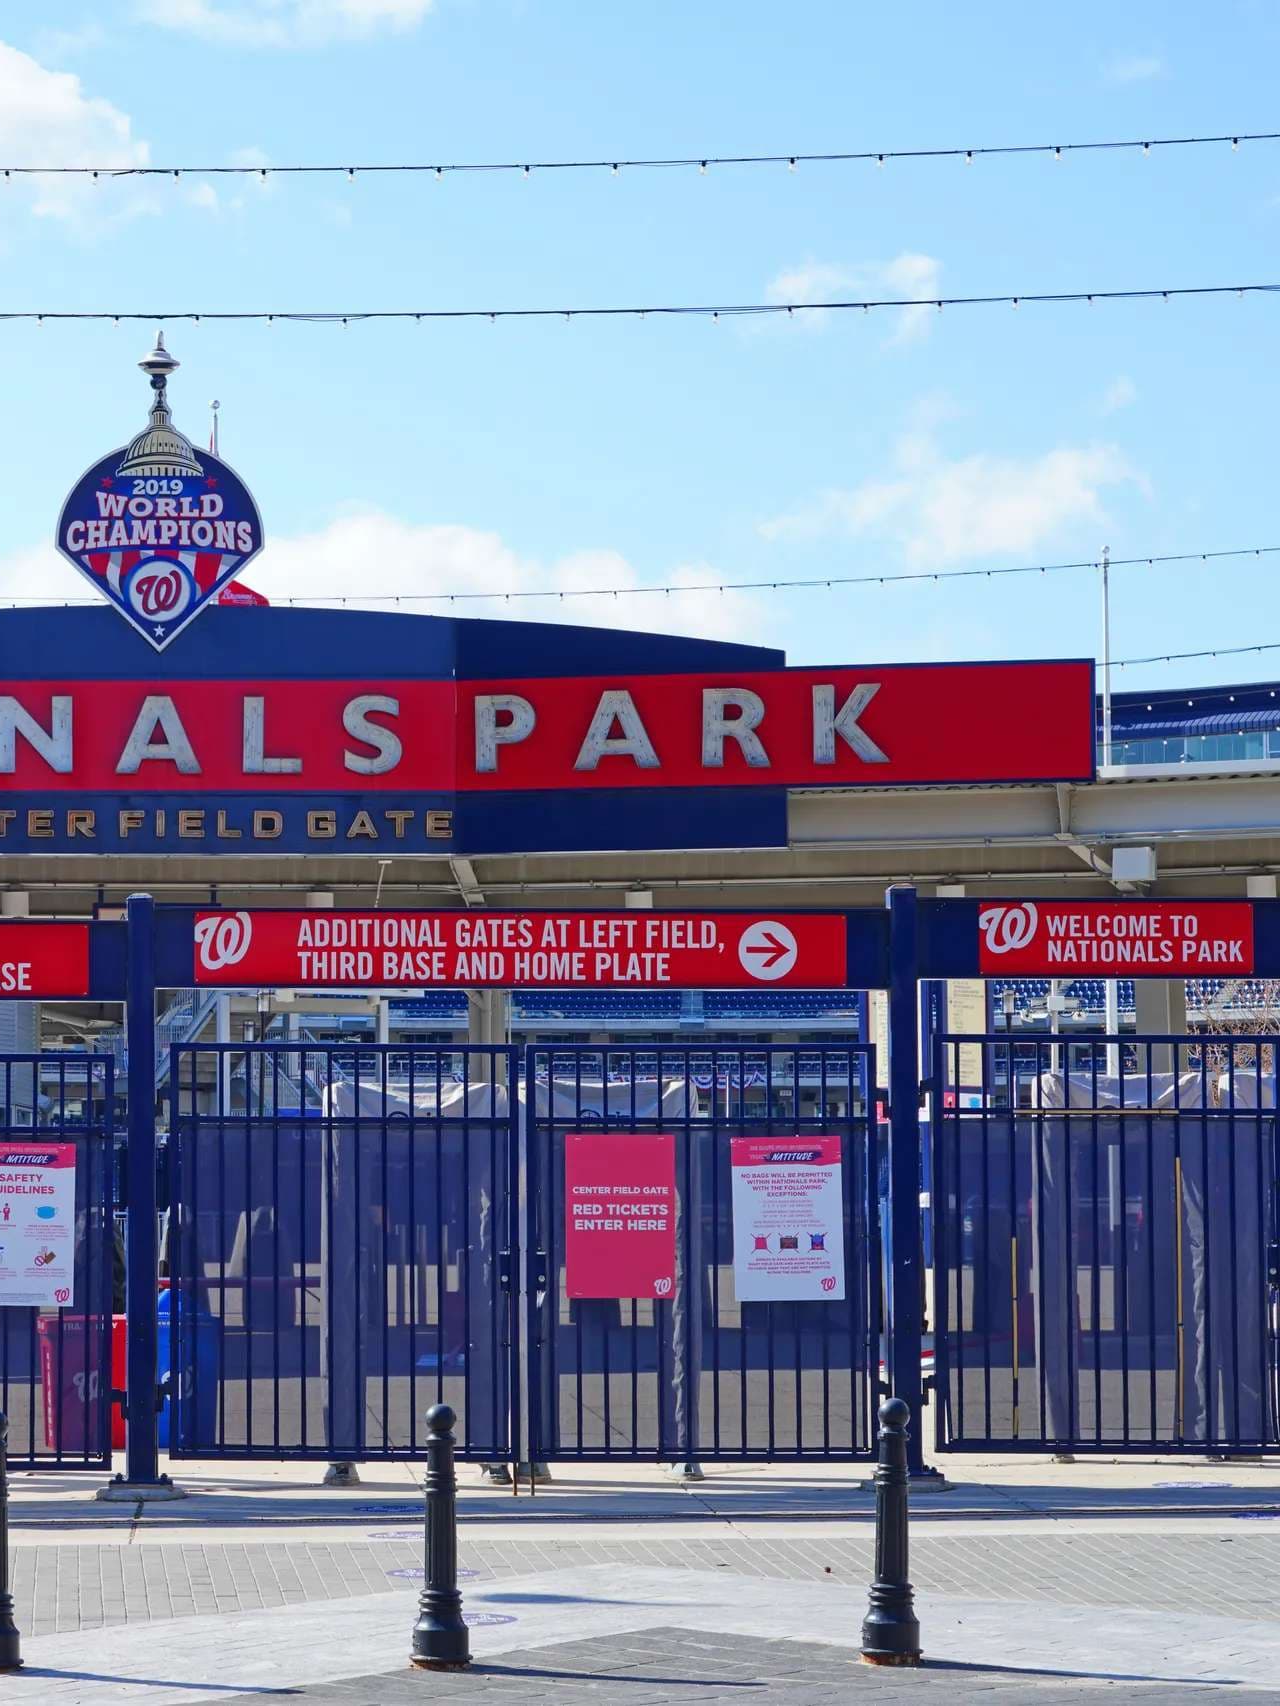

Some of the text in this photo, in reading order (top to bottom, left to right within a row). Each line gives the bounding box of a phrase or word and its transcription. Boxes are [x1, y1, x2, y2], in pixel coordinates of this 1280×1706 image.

[132, 479, 184, 495] 2019
[95, 491, 224, 518] WORLD
[66, 520, 253, 553] CHAMPIONS
[135, 570, 182, 616] W
[475, 682, 891, 774] PARK
[120, 810, 284, 838] FIELD
[307, 810, 453, 838] GATE
[298, 919, 725, 953] ADDITIONAL GATES AT LEFT FIELD,
[979, 902, 1038, 954] W
[1046, 915, 1198, 937] WELCOME TO
[194, 911, 252, 971] W
[1047, 940, 1244, 963] NATIONALS PARK
[298, 952, 670, 981] THIRD BASE AND HOME PLATE
[6, 1155, 49, 1164] NATITUDE
[771, 1152, 814, 1161] NATITUDE
[0, 1173, 43, 1182] SAFETY
[572, 1186, 669, 1194] CENTER FIELD GATE
[573, 1204, 668, 1215] RED TICKETS
[574, 1219, 667, 1231] ENTER HERE
[654, 1277, 671, 1295] W
[821, 1276, 836, 1291] W
[54, 1287, 70, 1303] W
